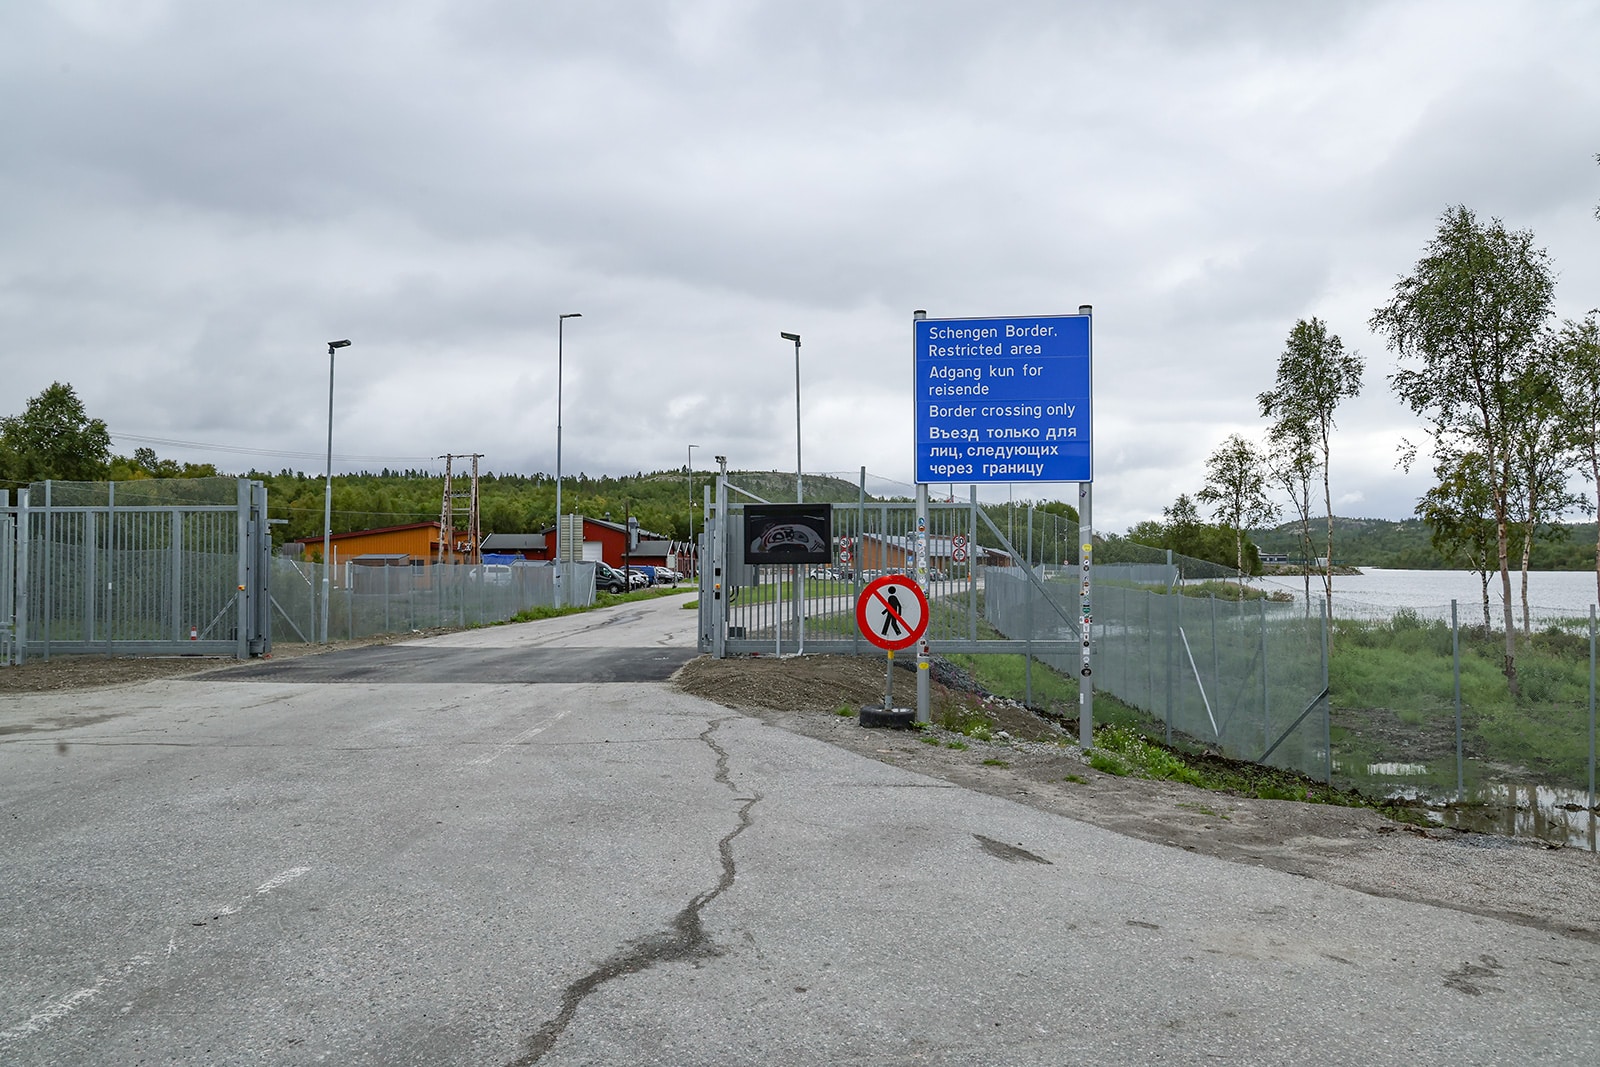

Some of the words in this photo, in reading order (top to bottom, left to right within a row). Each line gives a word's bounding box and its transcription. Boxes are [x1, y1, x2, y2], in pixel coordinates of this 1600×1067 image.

[929, 327, 998, 342] Schengen
[1005, 325, 1058, 338] Border.
[929, 343, 1002, 357] Restricted
[1010, 344, 1042, 355] area
[929, 366, 981, 381] Adgang
[989, 365, 1015, 377] kun
[1022, 364, 1044, 377] for
[929, 383, 990, 396] reisende
[929, 405, 977, 418] Border
[981, 404, 1042, 419] crossing
[1046, 403, 1076, 419] only
[929, 427, 979, 442] Въезд
[986, 427, 1040, 439] только
[1045, 428, 1077, 441] для
[929, 447, 963, 460] лиц,
[966, 446, 1059, 459] следующих
[929, 464, 973, 478] через
[982, 464, 1044, 477] границу
